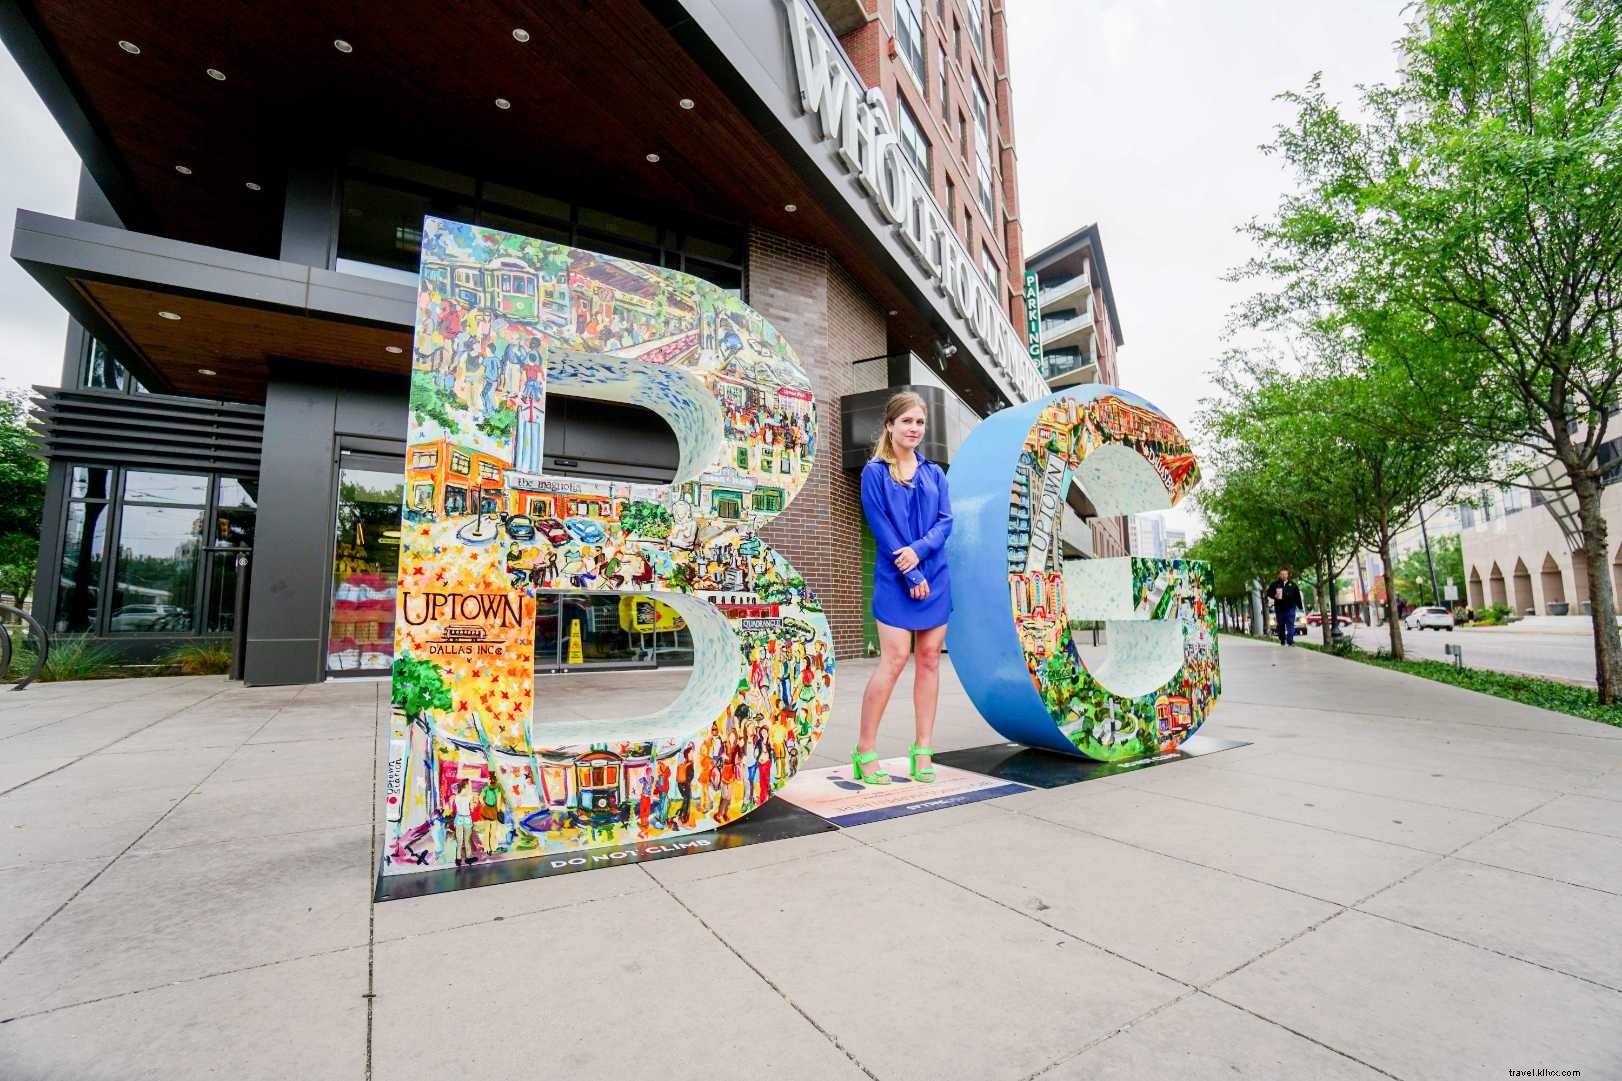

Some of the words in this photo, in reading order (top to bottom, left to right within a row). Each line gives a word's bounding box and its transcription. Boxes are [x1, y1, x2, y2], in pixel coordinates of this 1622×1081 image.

[1026, 275, 1040, 356] PARKING
[518, 478, 532, 487] the
[1032, 463, 1062, 552] UPTOWN
[403, 591, 525, 628] UPTOWN
[429, 645, 473, 655] DALLAS
[550, 857, 587, 869] DO
[592, 848, 639, 862] NOT
[646, 839, 712, 854] CLIMB
